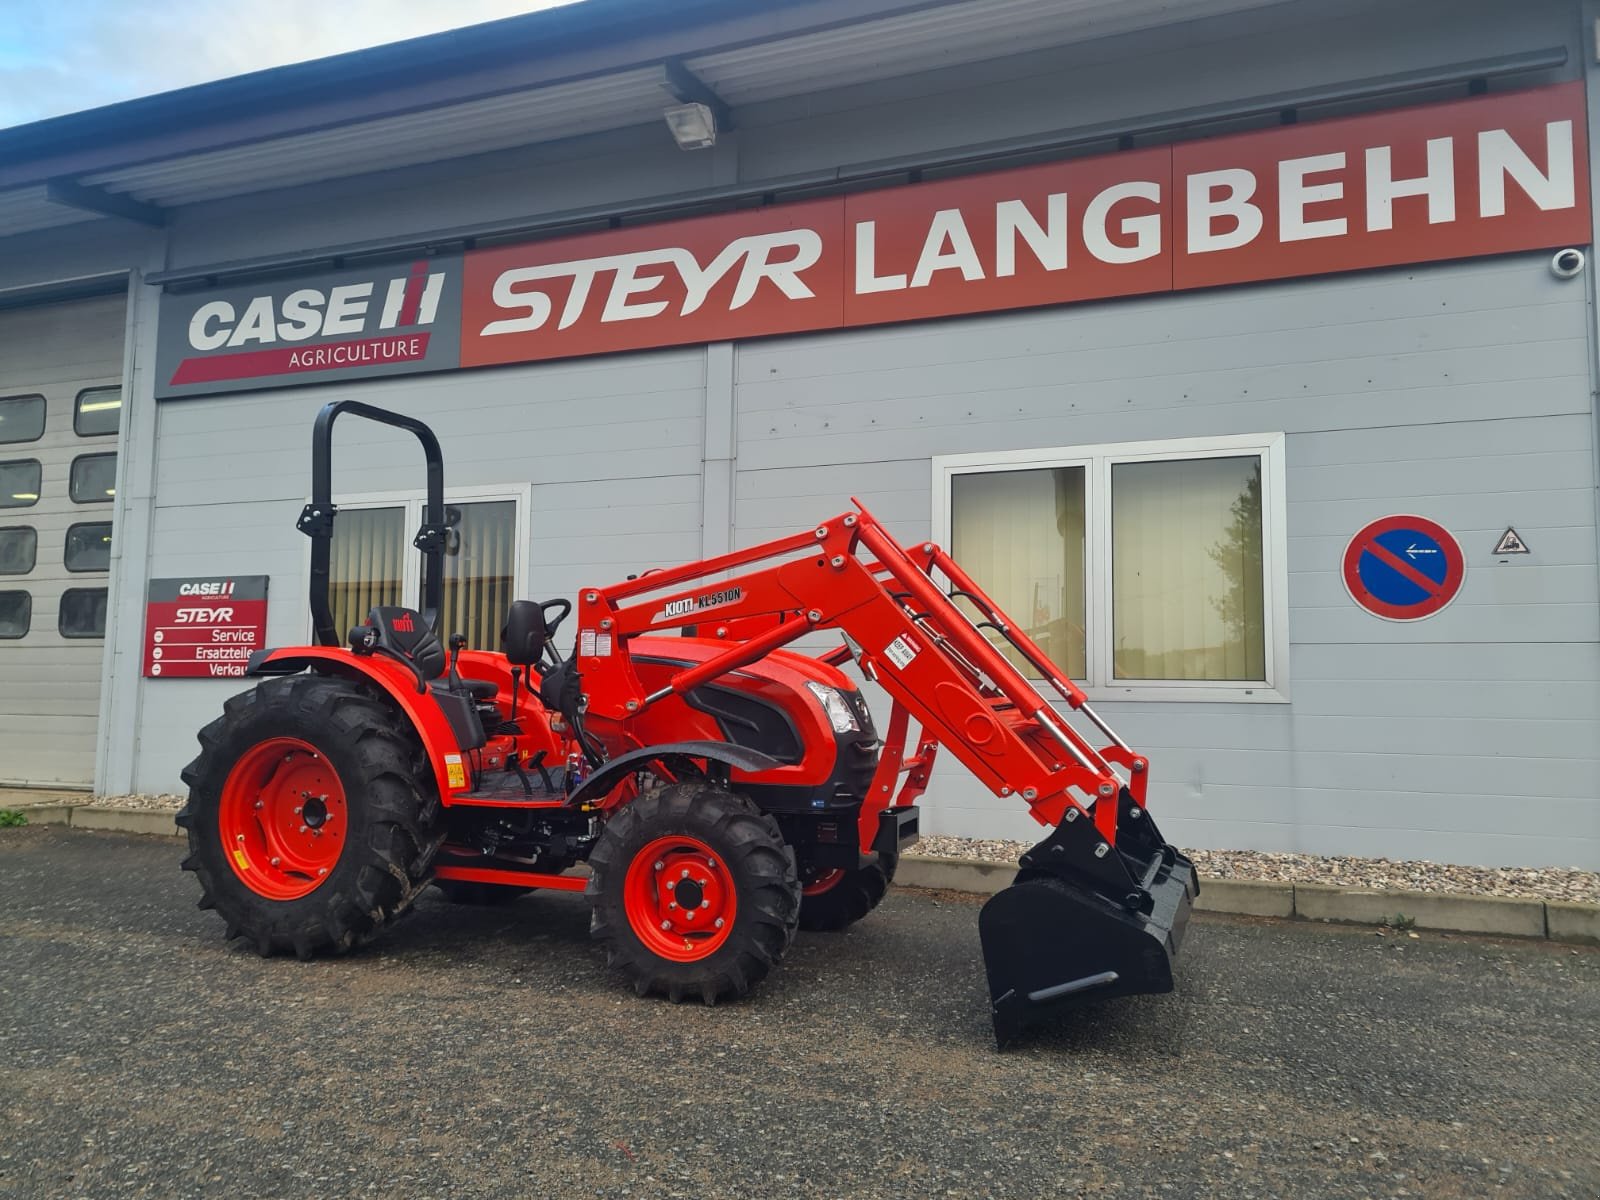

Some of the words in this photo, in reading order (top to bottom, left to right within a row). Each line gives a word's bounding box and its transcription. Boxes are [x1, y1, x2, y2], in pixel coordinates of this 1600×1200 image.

[480, 228, 823, 336] STEYR
[854, 119, 1576, 295] LANGBEHN
[187, 281, 375, 352] CASE
[288, 338, 420, 368] AGRICULTURE
[179, 582, 221, 595] CASE
[174, 607, 234, 623] STEYR
[665, 597, 694, 617] KIOTI
[212, 629, 255, 642] Service
[196, 646, 254, 659] Ersatzteile
[209, 663, 248, 676] Verkau
